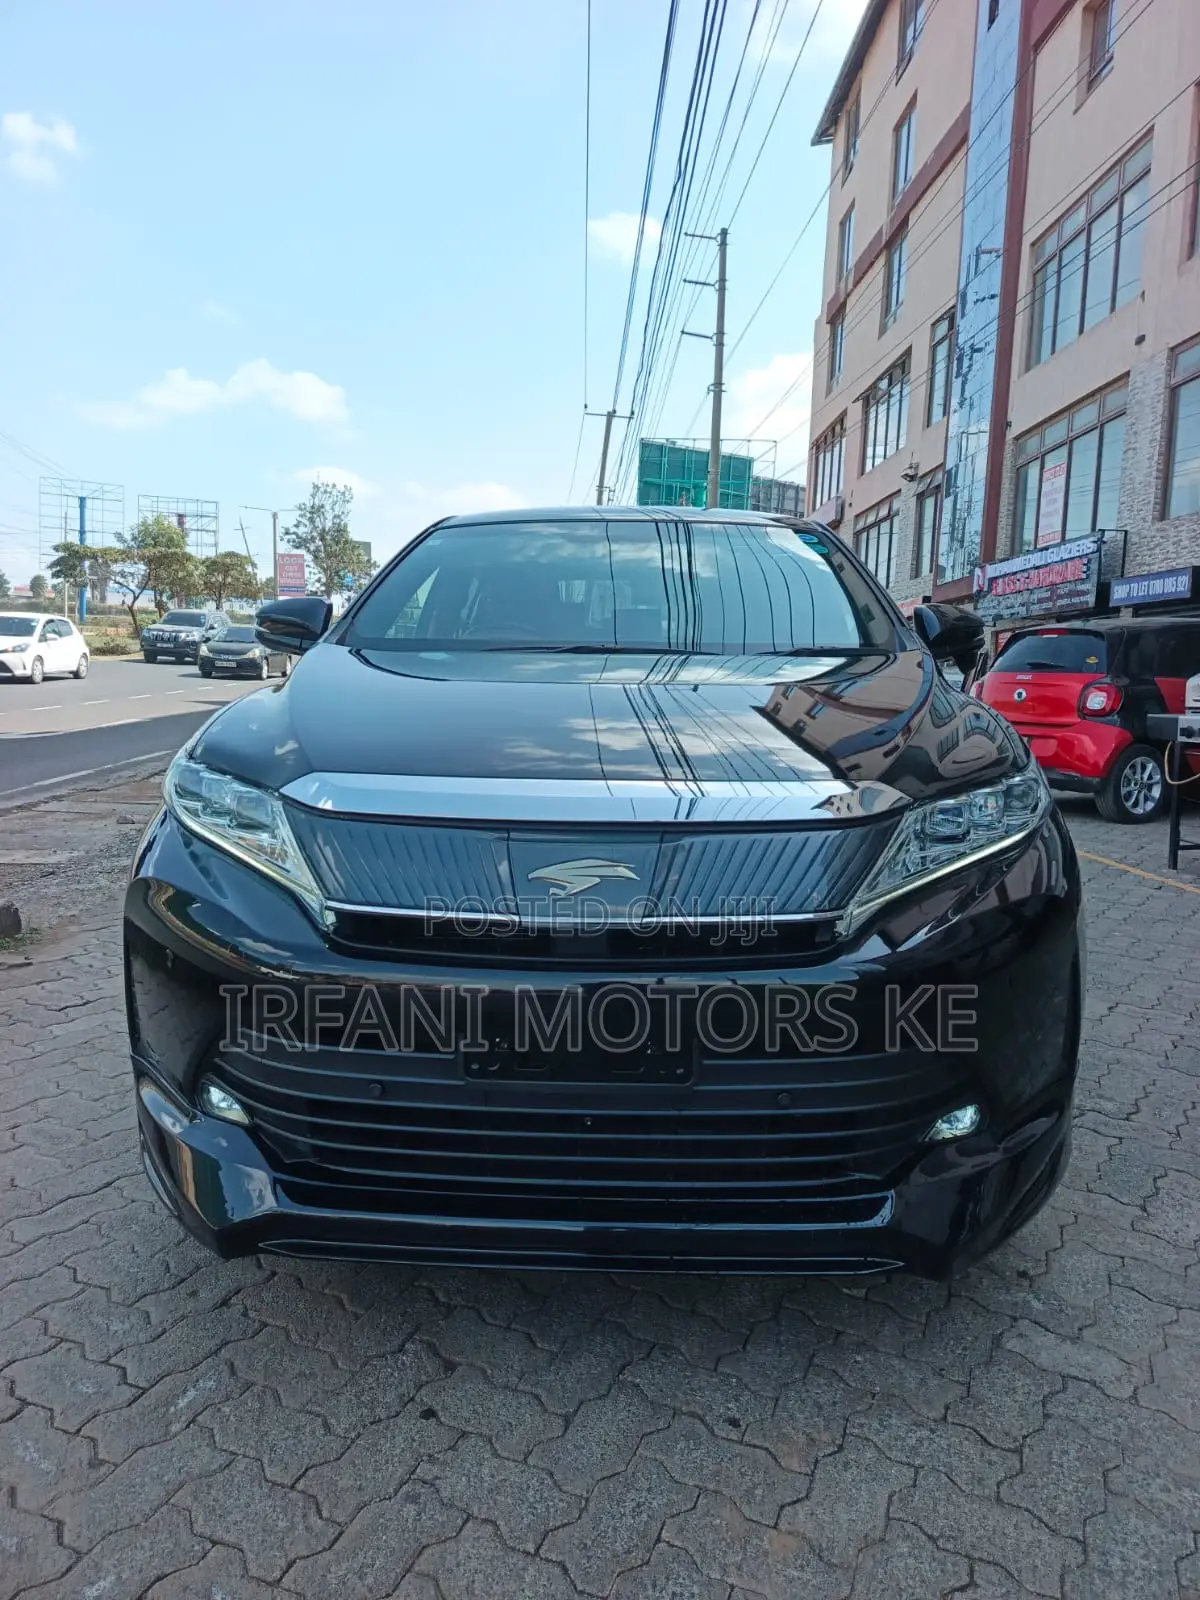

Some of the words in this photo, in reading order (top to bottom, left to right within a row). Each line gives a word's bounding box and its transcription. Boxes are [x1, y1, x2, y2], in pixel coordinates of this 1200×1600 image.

[1113, 584, 1130, 600] SHOP
[1130, 582, 1138, 597] TO
[1138, 580, 1148, 596] LET
